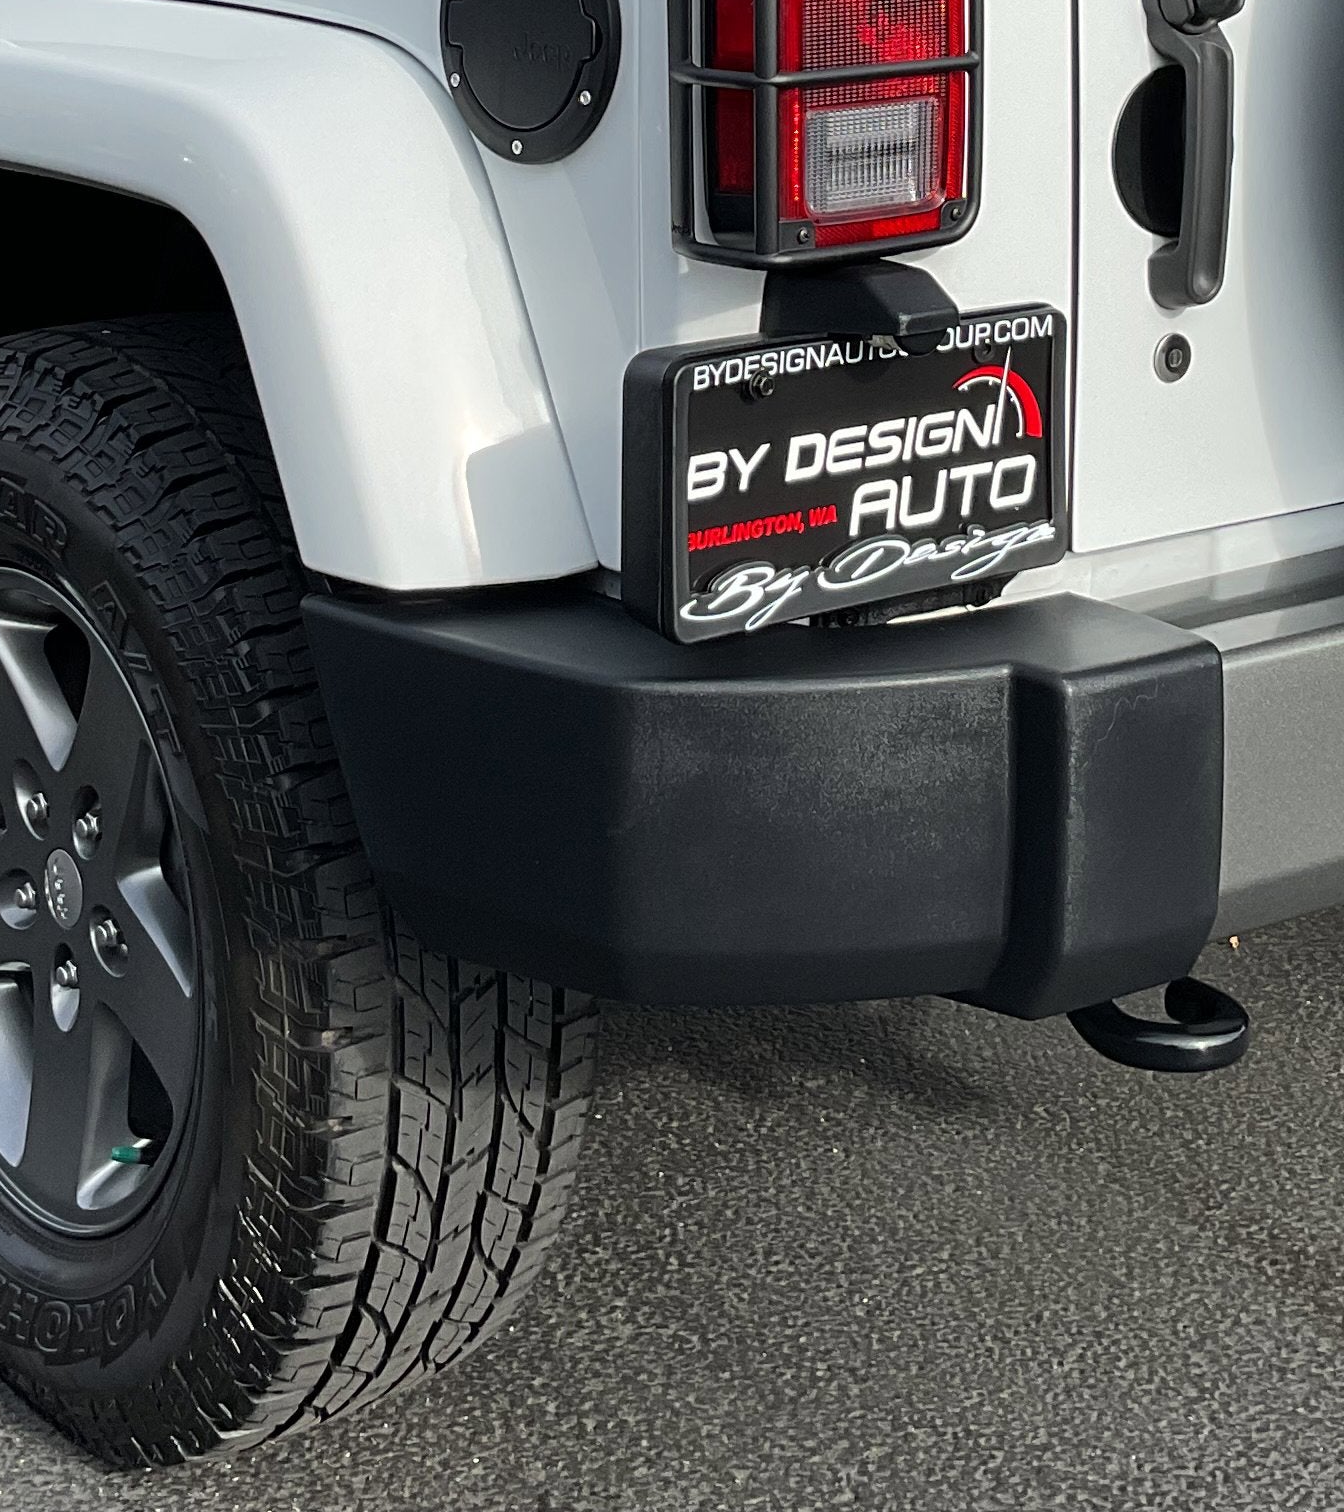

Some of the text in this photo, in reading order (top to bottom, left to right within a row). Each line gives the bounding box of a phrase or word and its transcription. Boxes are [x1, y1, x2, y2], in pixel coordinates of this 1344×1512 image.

[693, 316, 1053, 391] BYDESIGNAUOUP.COM
[687, 404, 1003, 502] BY DESIGN
[688, 504, 838, 552] BURLINGTON, WA
[848, 454, 1037, 537] AUTO
[680, 522, 1055, 632] By Design
